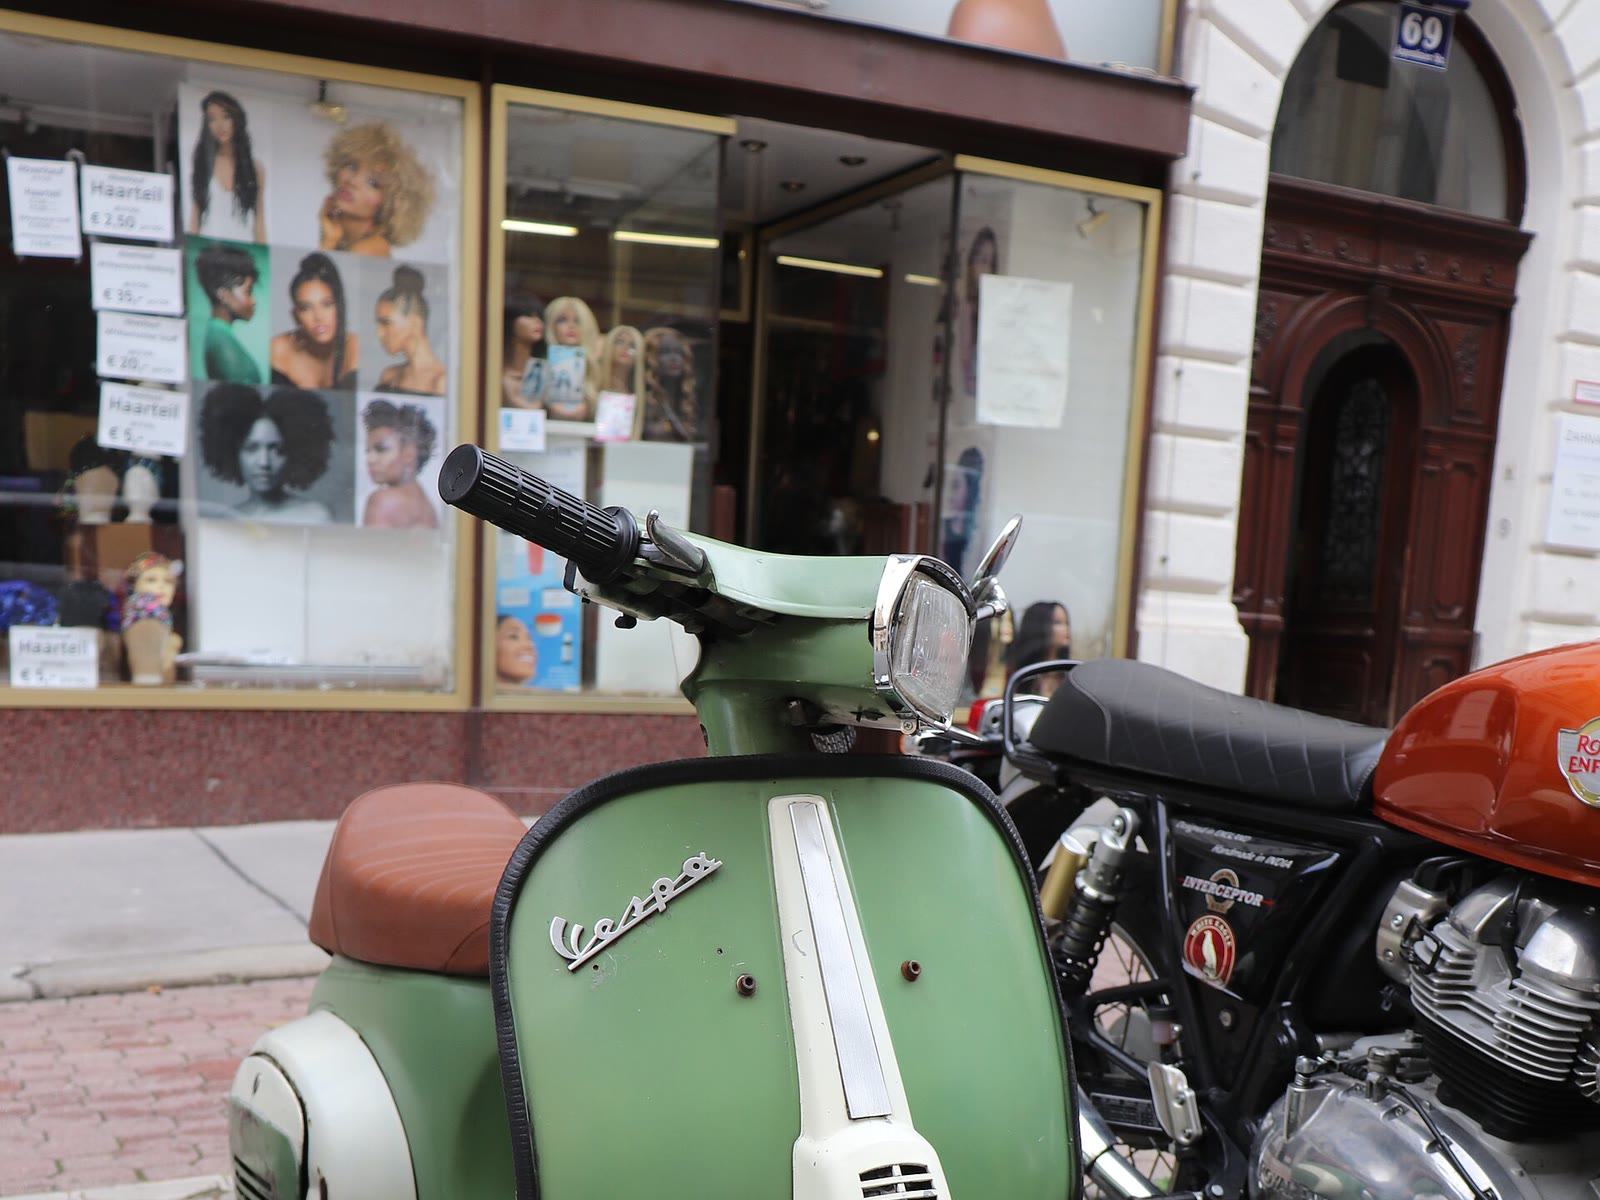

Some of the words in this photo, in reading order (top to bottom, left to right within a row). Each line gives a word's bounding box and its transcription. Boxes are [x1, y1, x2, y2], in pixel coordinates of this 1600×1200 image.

[1402, 12, 1443, 50] 69
[90, 180, 164, 204] Haarteil
[90, 211, 100, 224] €
[109, 395, 179, 419] Haarteil
[109, 426, 119, 439] €
[19, 640, 87, 656] Haarteil
[1214, 829, 1253, 842] ENGLAND
[1211, 844, 1256, 861] Handmade
[1265, 855, 1294, 869] INDIA
[1182, 875, 1264, 907] INTERCEPTOR
[550, 852, 723, 971] Vespa
[1190, 919, 1214, 936] WHITE
[1214, 919, 1233, 947] EAGLE
